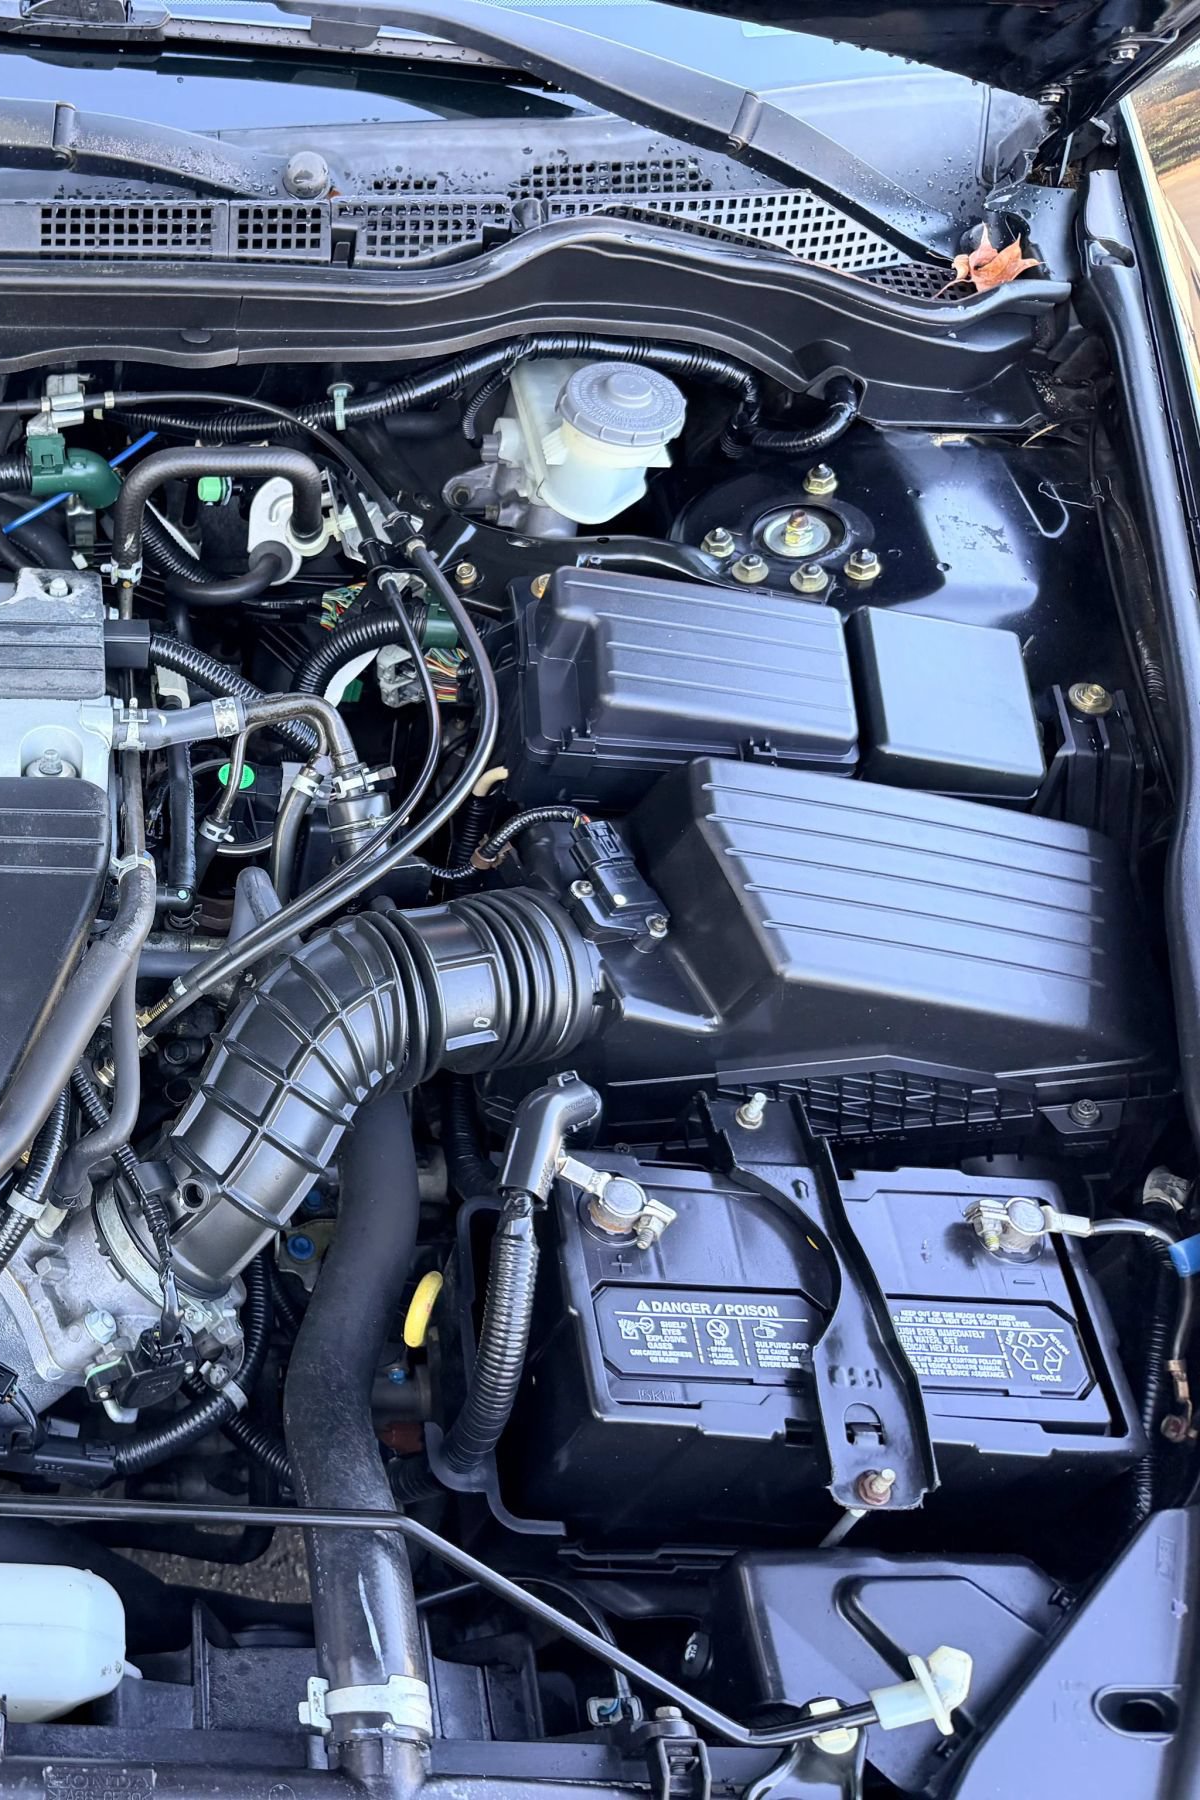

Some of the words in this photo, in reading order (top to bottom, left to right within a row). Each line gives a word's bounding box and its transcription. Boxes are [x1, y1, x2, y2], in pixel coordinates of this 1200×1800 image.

[651, 1301, 711, 1315] DANGER
[724, 1304, 780, 1317] POISON
[916, 1328, 937, 1336] EYES
[937, 1329, 985, 1339] IMMEDIATELY
[645, 1335, 688, 1344] EXPLOSIVE
[943, 1337, 958, 1345] GET
[755, 1341, 791, 1349] SULFURIC
[902, 1343, 928, 1351] EDICAL
[929, 1343, 949, 1352] HELP
[950, 1344, 969, 1353] FAST
[1031, 1373, 1062, 1382] RECYCLE
